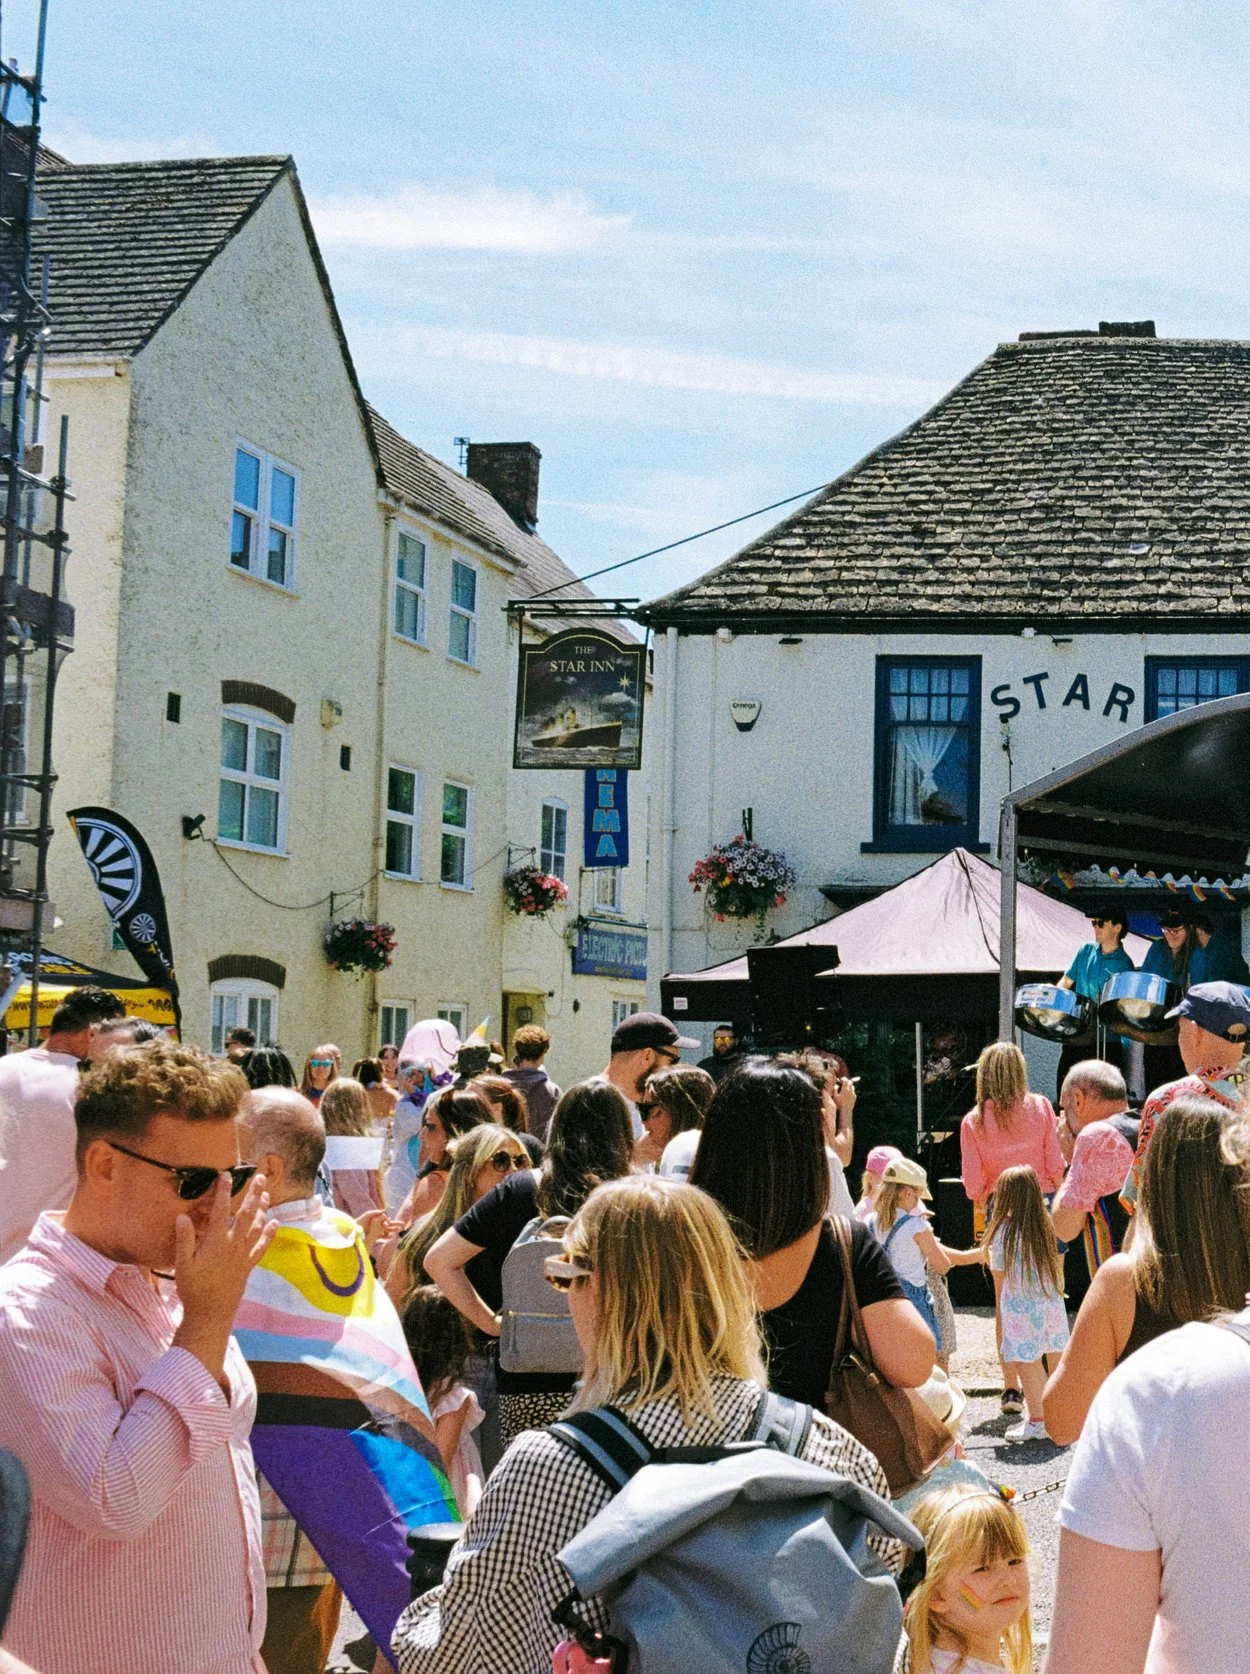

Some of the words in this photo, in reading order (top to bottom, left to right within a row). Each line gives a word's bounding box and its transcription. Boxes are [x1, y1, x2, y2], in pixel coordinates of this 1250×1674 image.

[574, 645, 593, 655] THE
[550, 660, 586, 672] STAR
[590, 660, 616, 673] INN
[990, 671, 1135, 724] STAR
